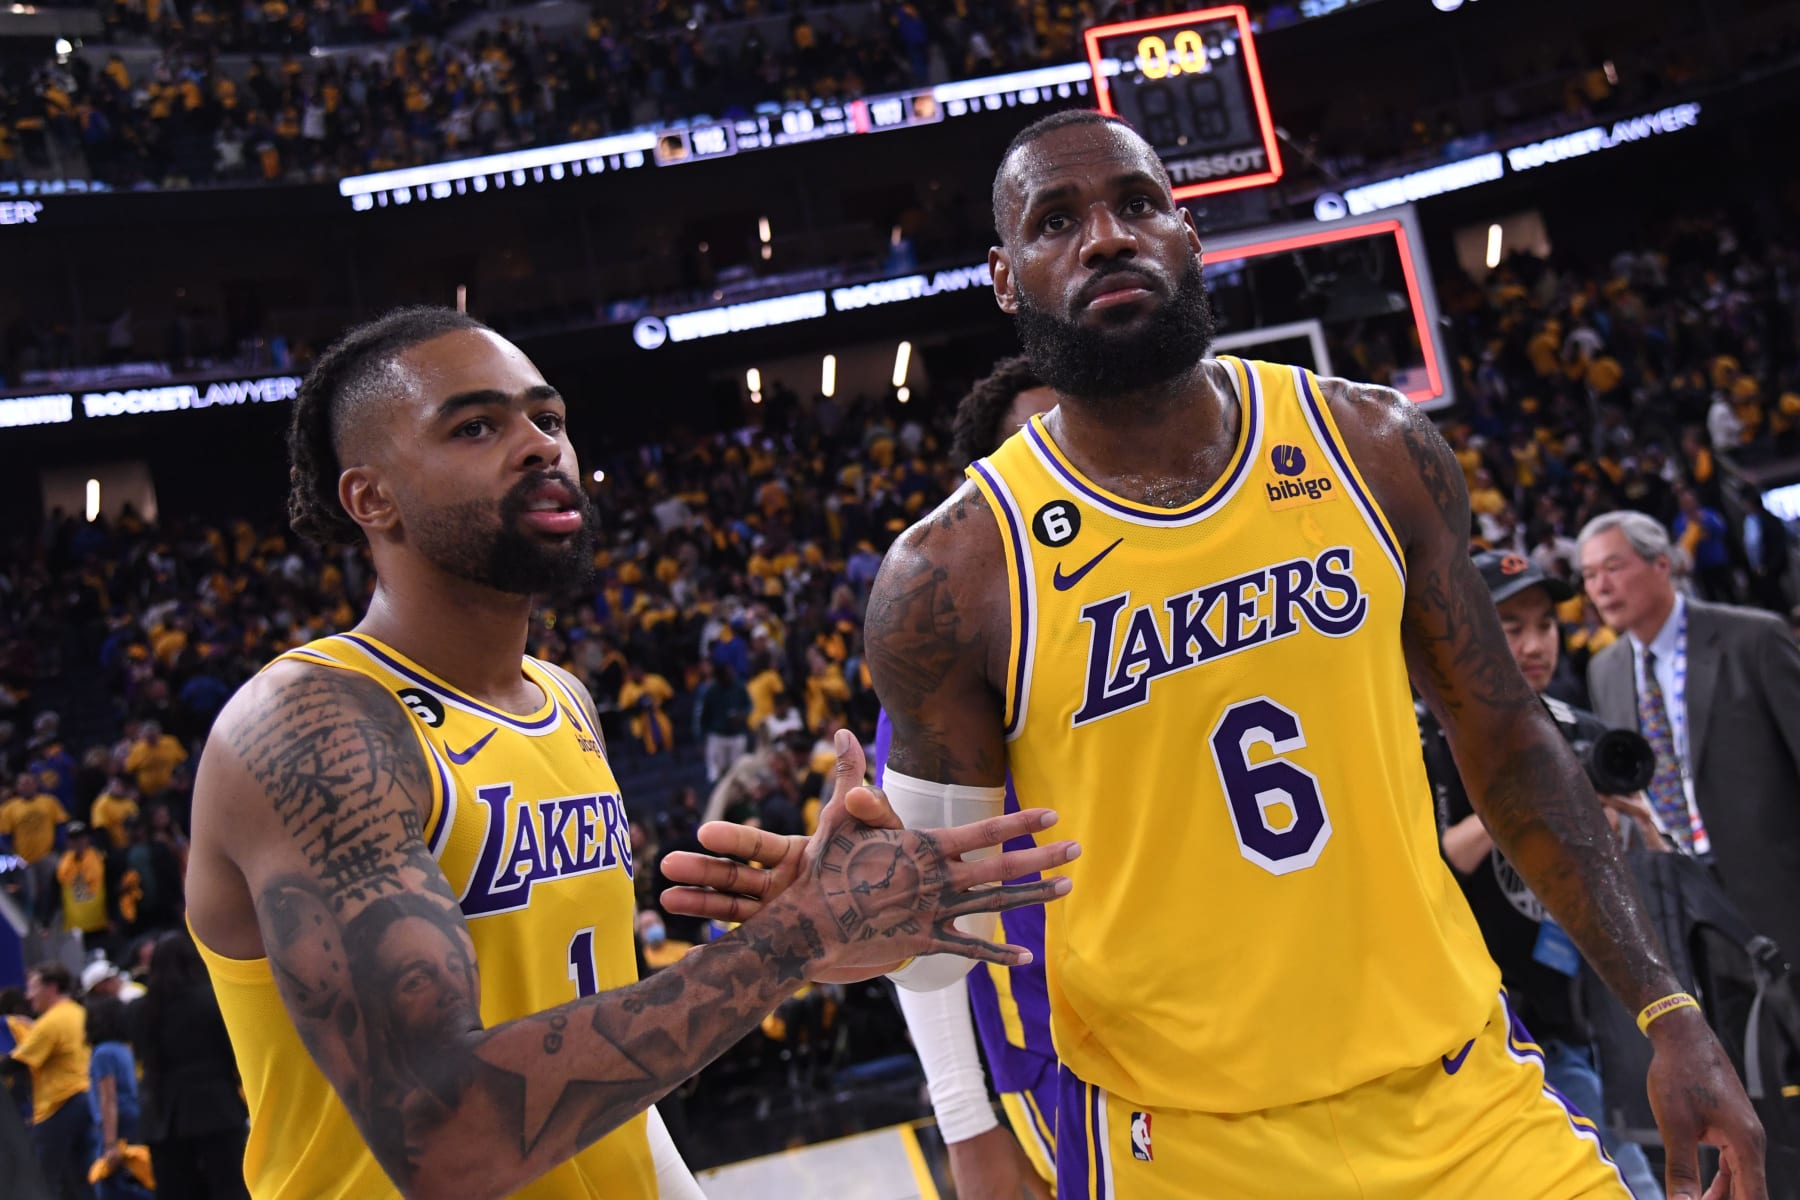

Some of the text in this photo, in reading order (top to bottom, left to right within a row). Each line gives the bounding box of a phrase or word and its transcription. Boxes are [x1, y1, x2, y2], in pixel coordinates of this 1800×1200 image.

[1138, 30, 1206, 79] 0.0
[1167, 151, 1266, 183] TISSOT
[1266, 476, 1333, 502] bibigo
[1042, 506, 1073, 542] 6
[1072, 546, 1369, 729] LAKERS
[1208, 695, 1333, 876] 6
[460, 781, 633, 920] LAKERS
[567, 926, 600, 1000] 1
